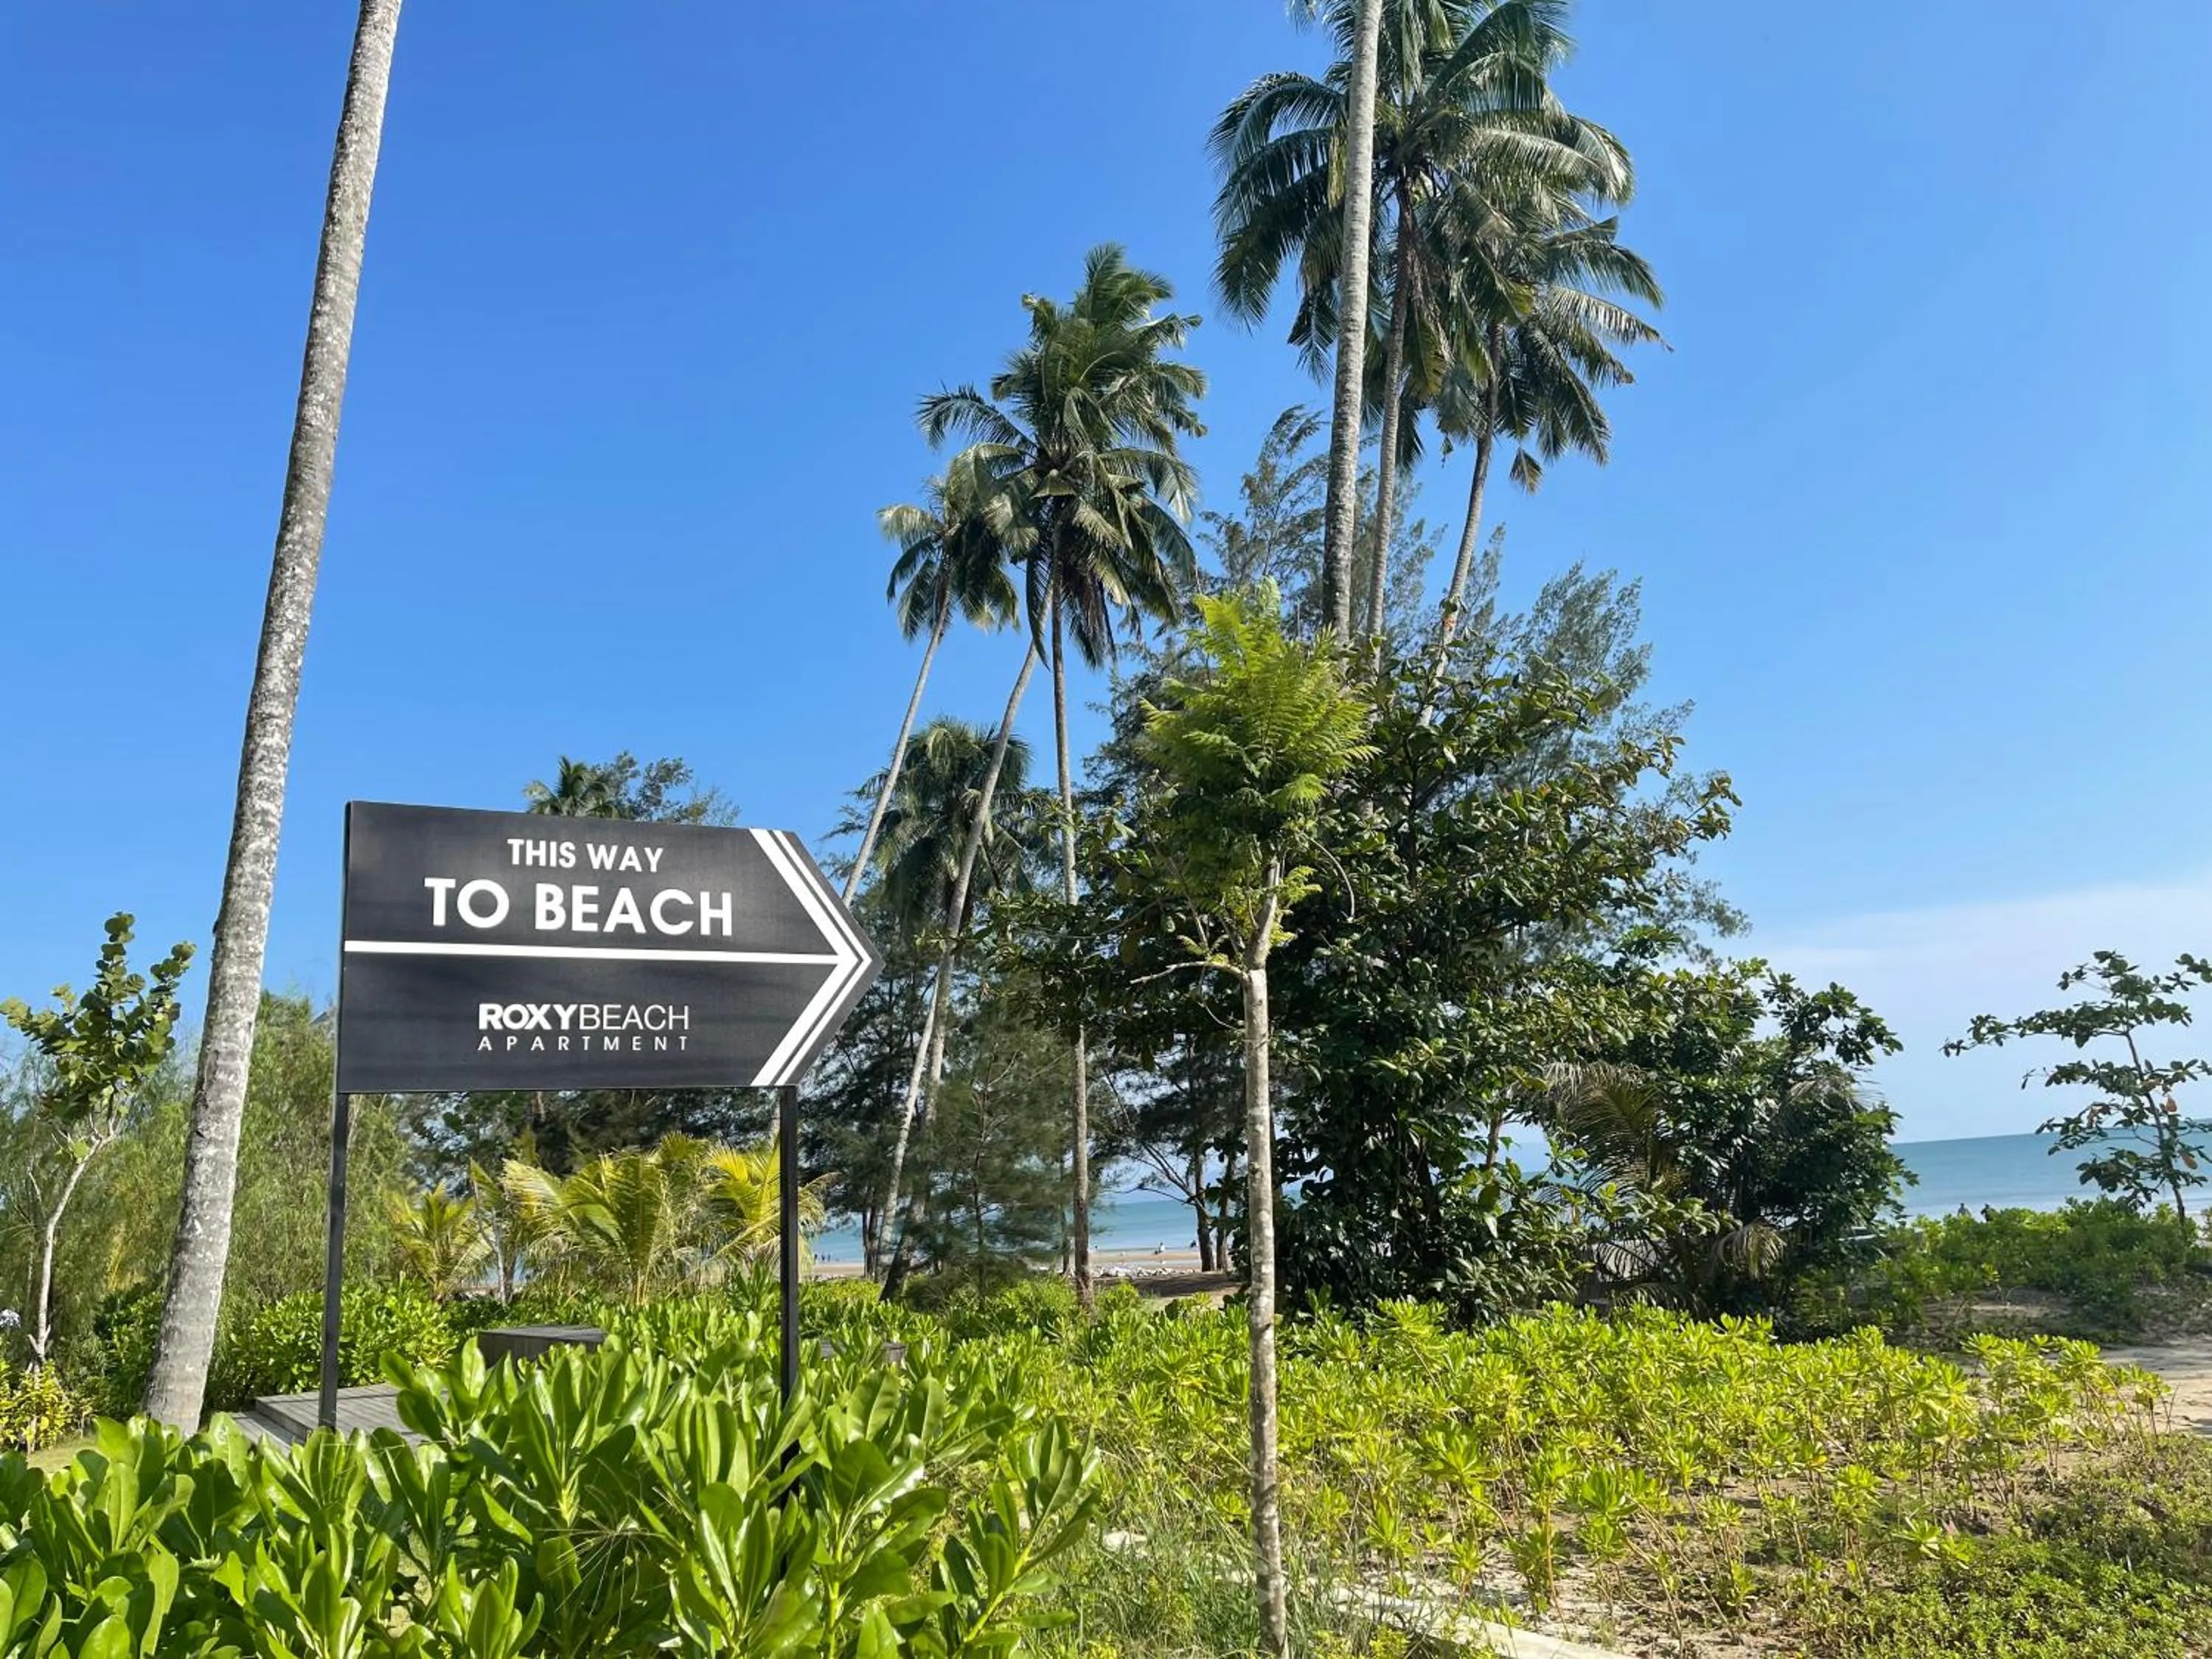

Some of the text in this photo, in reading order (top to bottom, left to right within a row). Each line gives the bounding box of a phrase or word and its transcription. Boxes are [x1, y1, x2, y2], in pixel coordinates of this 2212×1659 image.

[507, 838, 664, 874] THIS WAY
[424, 877, 734, 937] TO BEACH
[477, 1035, 688, 1051] APARTMENT
